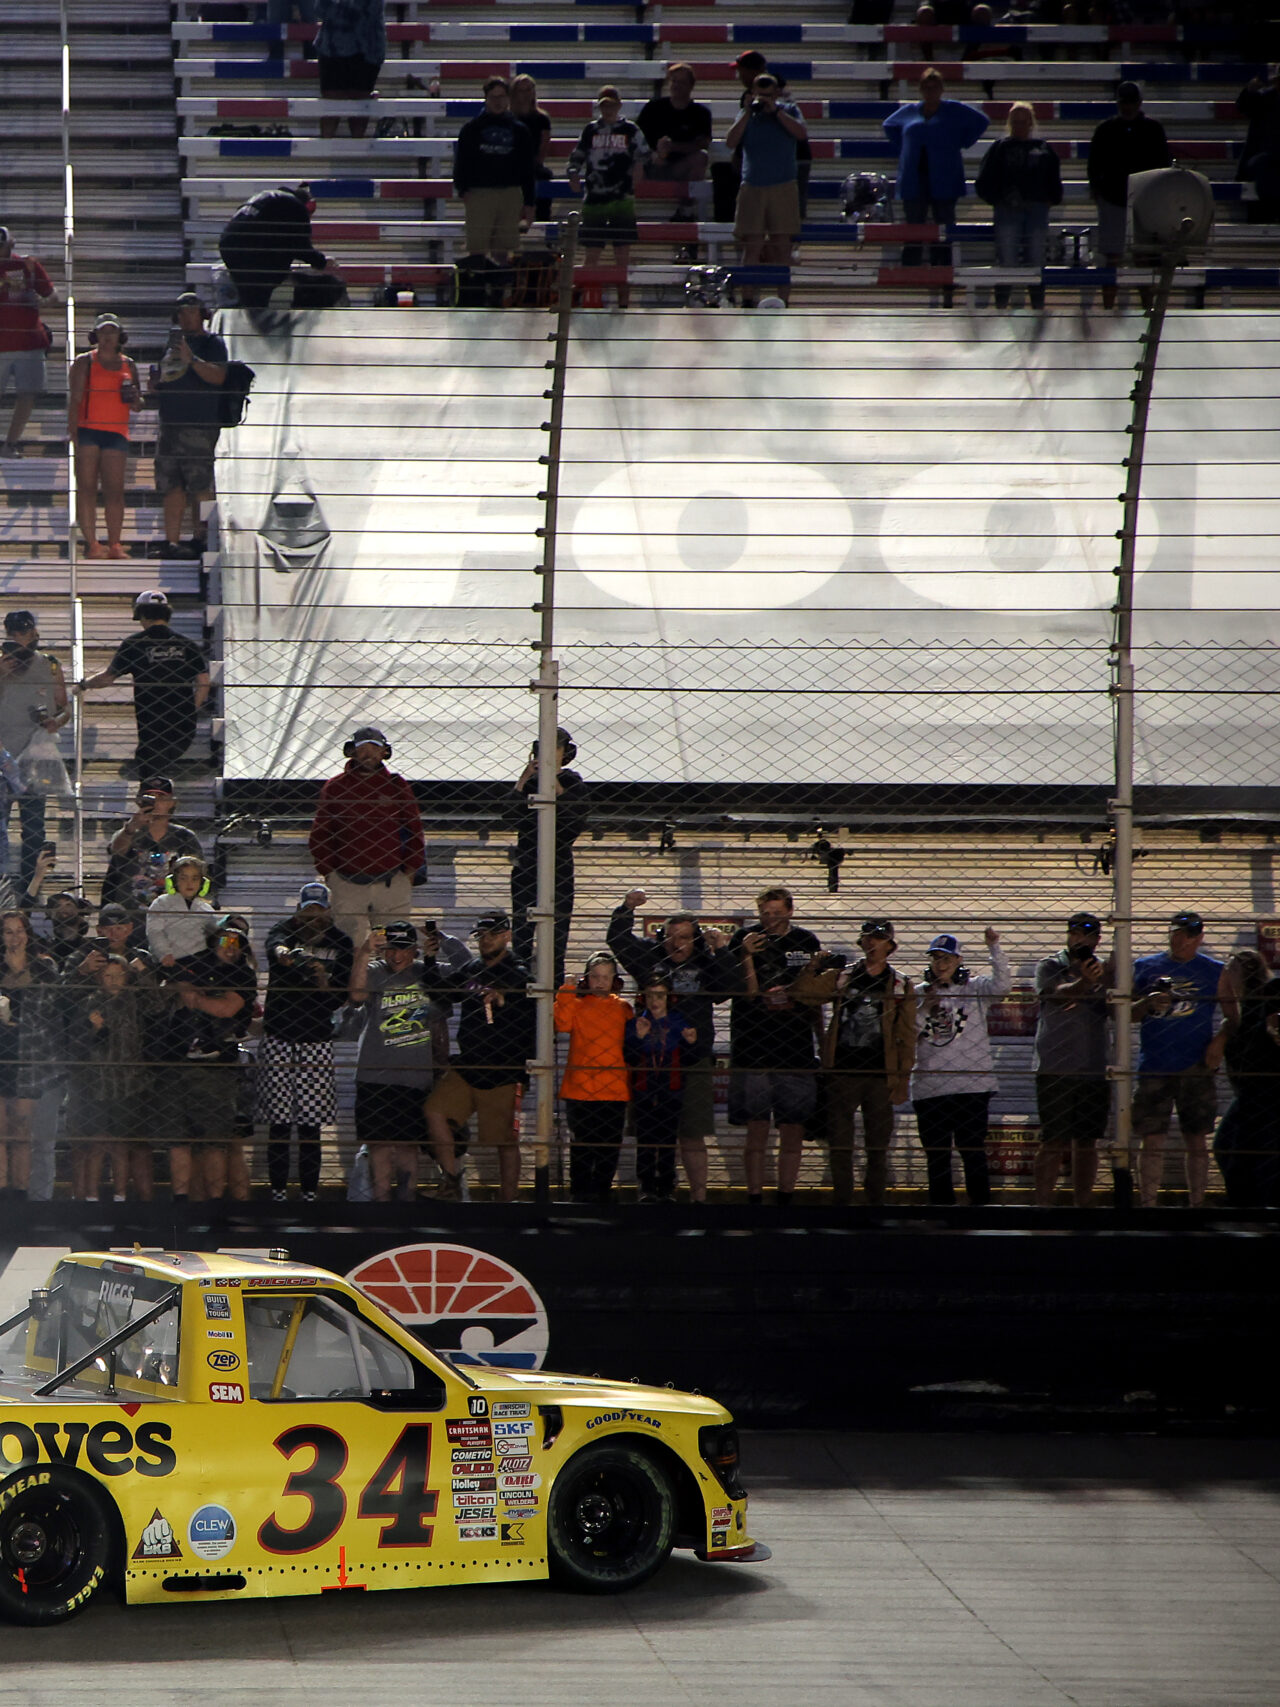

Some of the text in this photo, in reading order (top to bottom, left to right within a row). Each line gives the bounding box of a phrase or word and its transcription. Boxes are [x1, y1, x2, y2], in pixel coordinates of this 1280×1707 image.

[248, 1277, 318, 1287] RIGGS
[206, 1295, 227, 1304] BUILT
[211, 1385, 243, 1402] SEM
[471, 1399, 486, 1414] 10
[448, 1426, 489, 1435] CRAFTSMAN
[494, 1422, 533, 1435] SKF
[452, 1449, 492, 1460] COMETIC
[501, 1459, 530, 1469] KLOTZ
[257, 1422, 440, 1556] 34
[452, 1479, 480, 1491] Holley
[456, 1495, 495, 1506] tilton
[500, 1491, 532, 1499] LINCOLN
[455, 1507, 497, 1519] JESEL
[195, 1519, 229, 1532] CLEW
[66, 1565, 105, 1611] EAGLE
